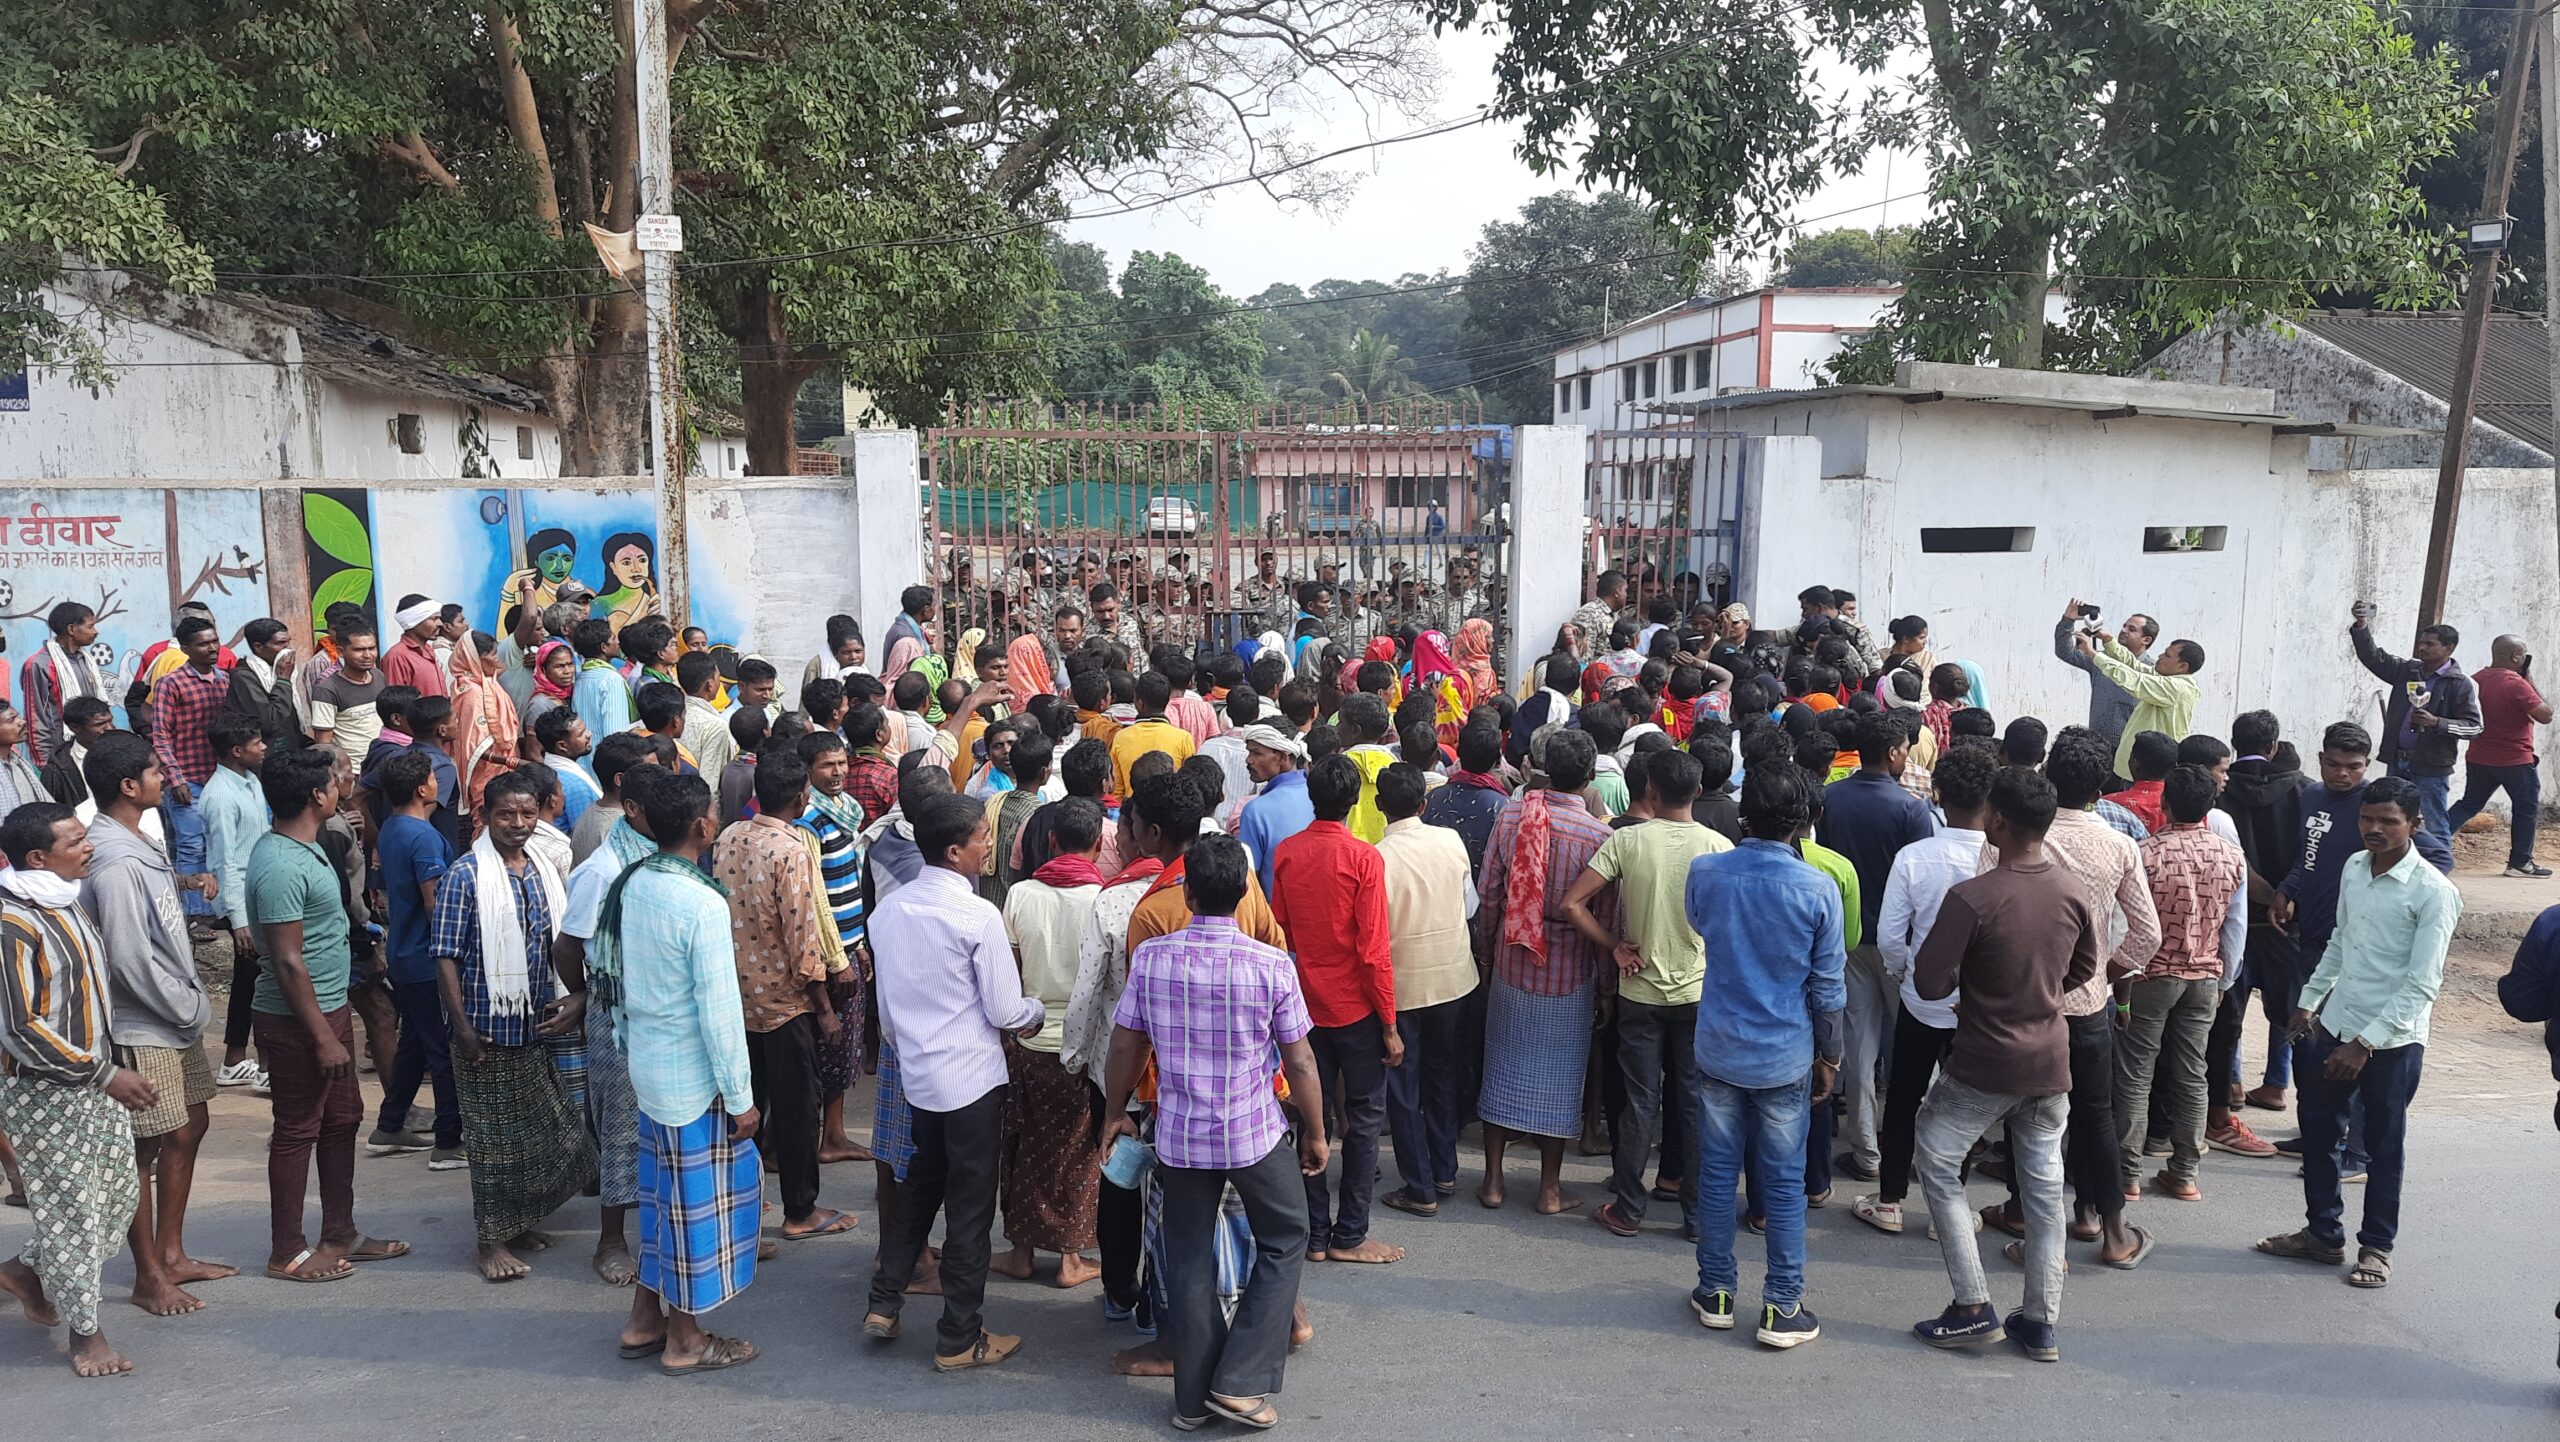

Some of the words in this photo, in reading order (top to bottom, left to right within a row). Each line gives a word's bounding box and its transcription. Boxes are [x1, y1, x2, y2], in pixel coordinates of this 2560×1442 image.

[648, 217, 668, 225] DANGER
[18, 503, 134, 551] दीवार
[2304, 811, 2333, 872] FASHION
[1933, 1321, 1990, 1335] Champion
